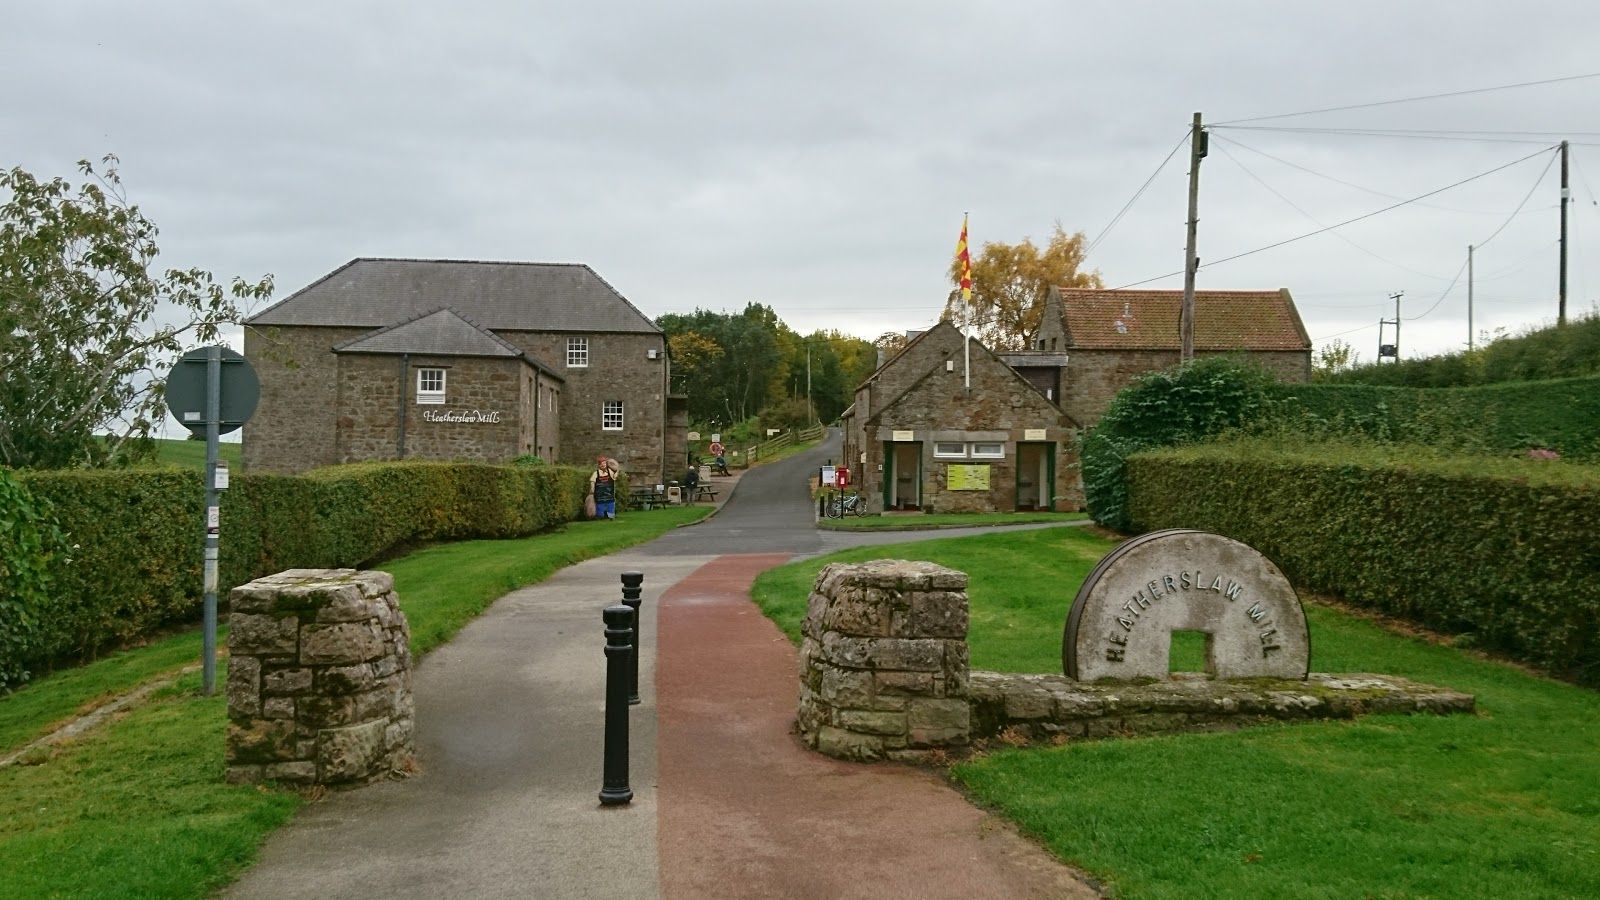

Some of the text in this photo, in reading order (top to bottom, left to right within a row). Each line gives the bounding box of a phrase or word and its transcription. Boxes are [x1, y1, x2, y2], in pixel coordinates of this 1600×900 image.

[423, 410, 500, 423] Heatherslaw Mill
[1106, 570, 1281, 662] HEATHERSLAW MILL
